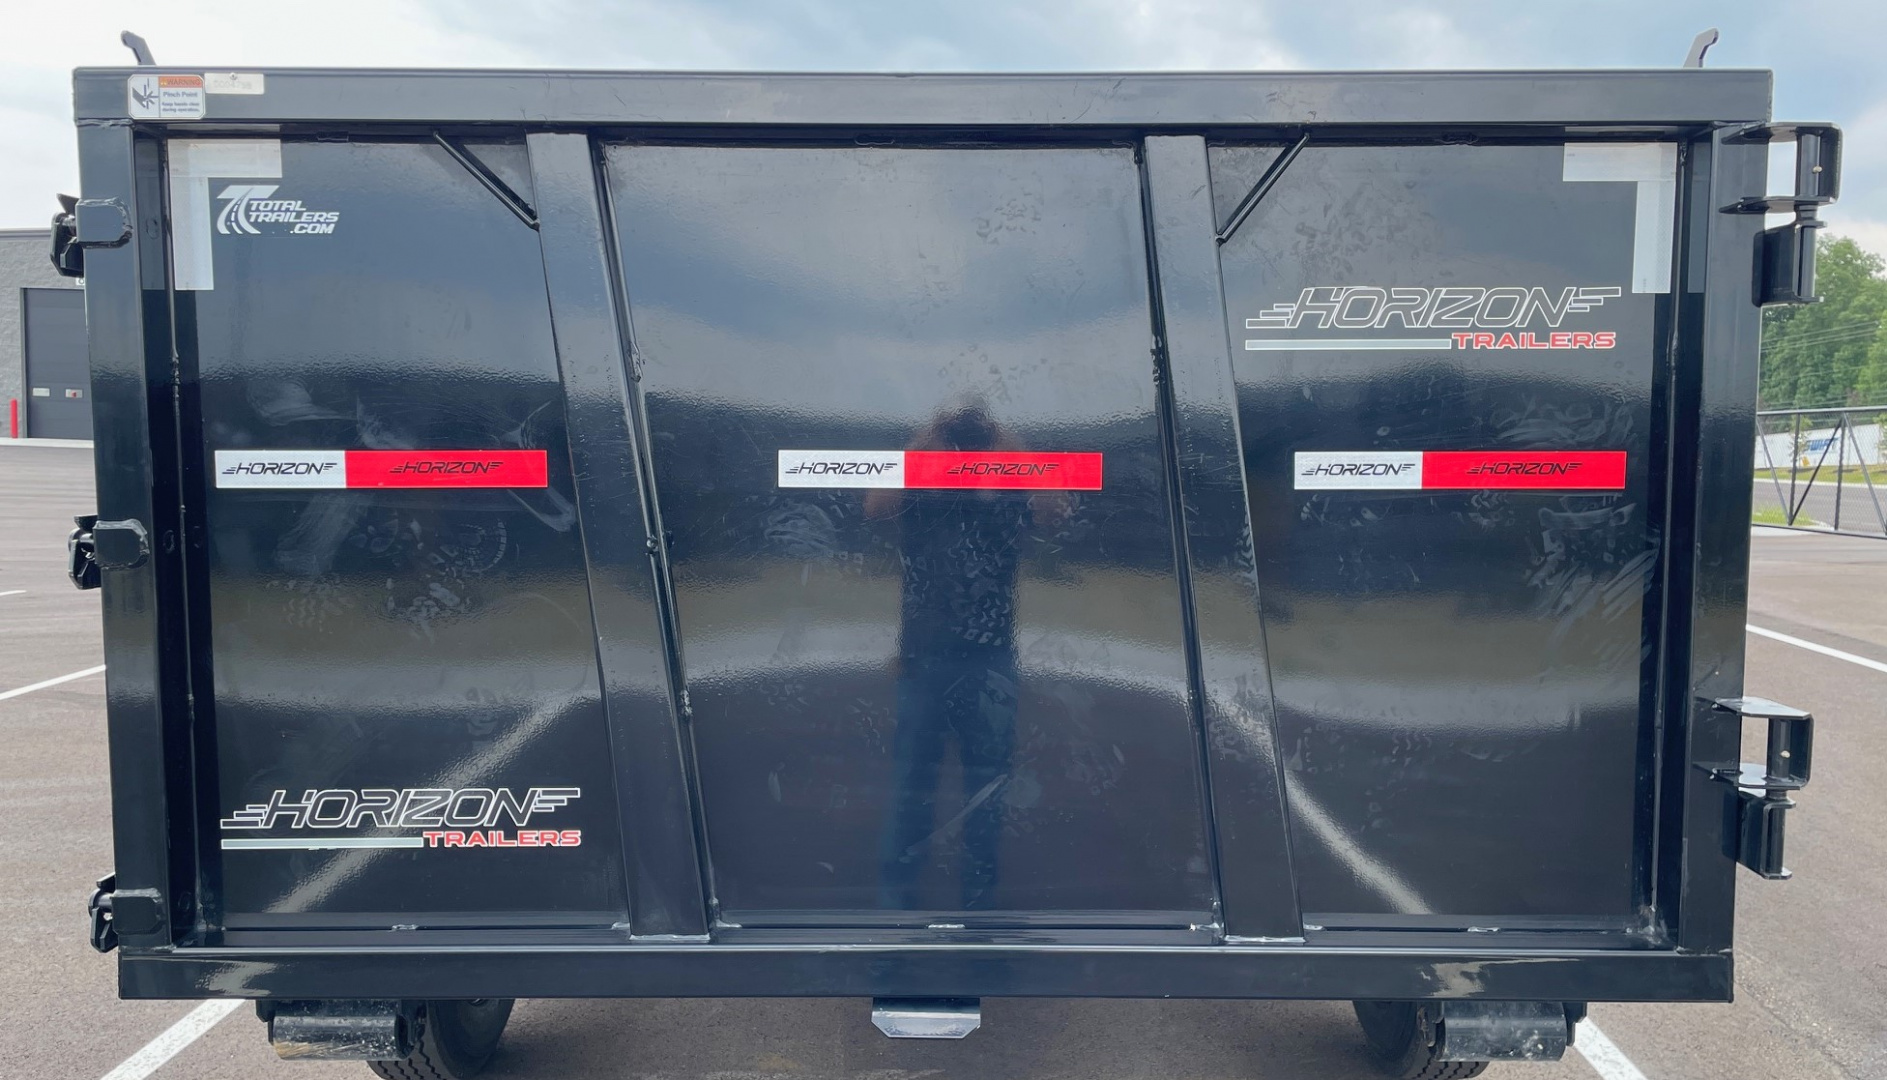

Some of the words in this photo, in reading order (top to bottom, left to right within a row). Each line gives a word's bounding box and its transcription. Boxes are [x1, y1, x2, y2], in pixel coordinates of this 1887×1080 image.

[167, 77, 201, 87] WARNING
[249, 200, 307, 211] TOTAL
[249, 211, 340, 223] TRAILERS
[290, 223, 335, 234] .COM
[1287, 286, 1577, 329] HORIZON
[1451, 332, 1617, 350] TRAILERS
[235, 461, 326, 476] HORIZON
[401, 461, 493, 475] HORIZON
[798, 462, 887, 476] HORIZON
[958, 462, 1048, 476] HORIZON
[1314, 463, 1405, 476] HORIZON
[1478, 462, 1572, 476] HORIZON
[260, 787, 542, 829] HORIZON
[422, 830, 582, 848] TRAILERS
